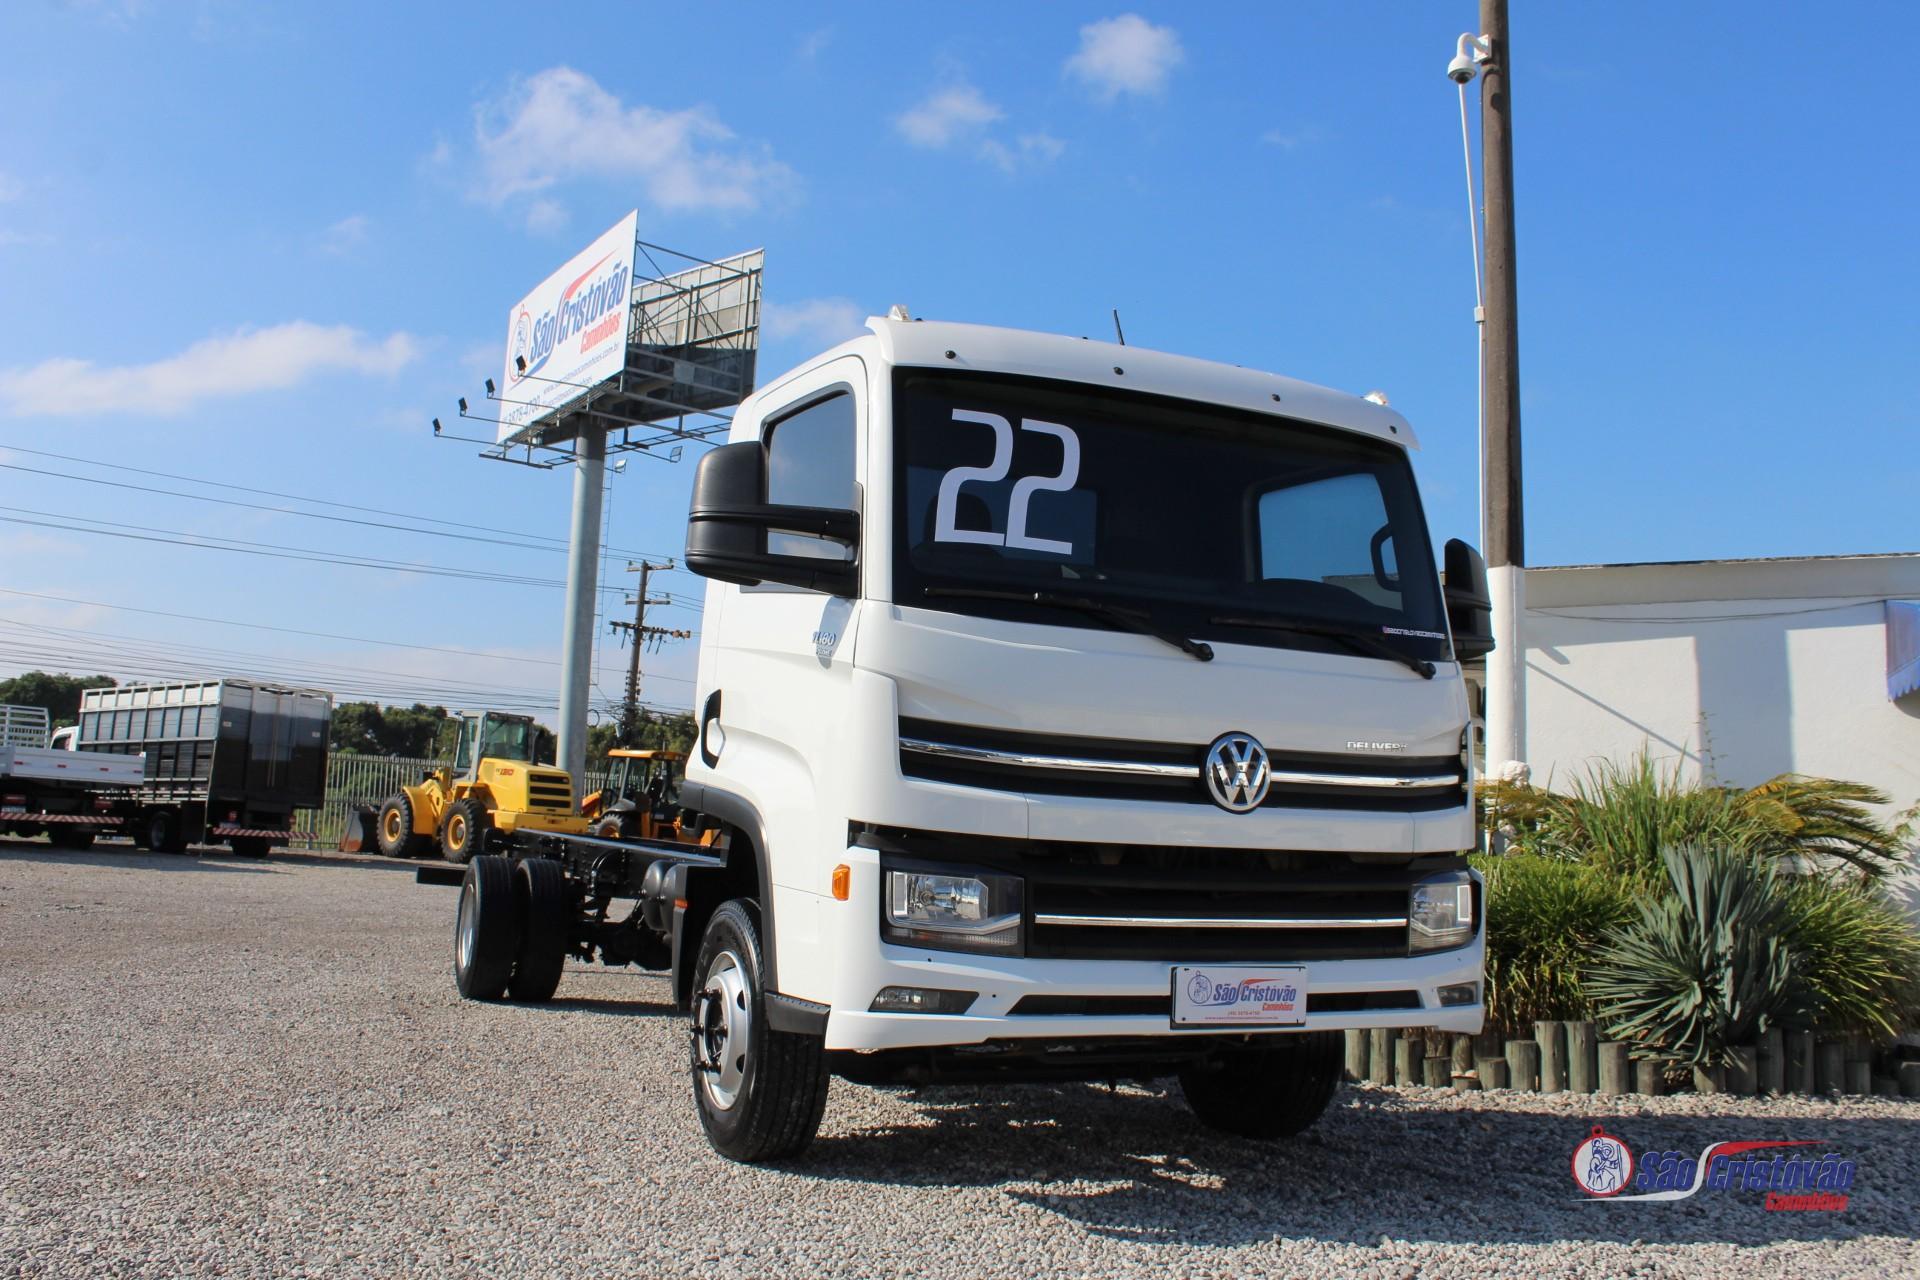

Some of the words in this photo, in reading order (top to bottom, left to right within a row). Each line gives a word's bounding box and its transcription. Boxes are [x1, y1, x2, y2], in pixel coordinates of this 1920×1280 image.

[530, 310, 555, 363] São
[557, 260, 628, 344] Cristóvão
[934, 408, 1080, 555] 22
[1213, 984, 1236, 1001] São
[1240, 985, 1296, 1002] Cristóvão
